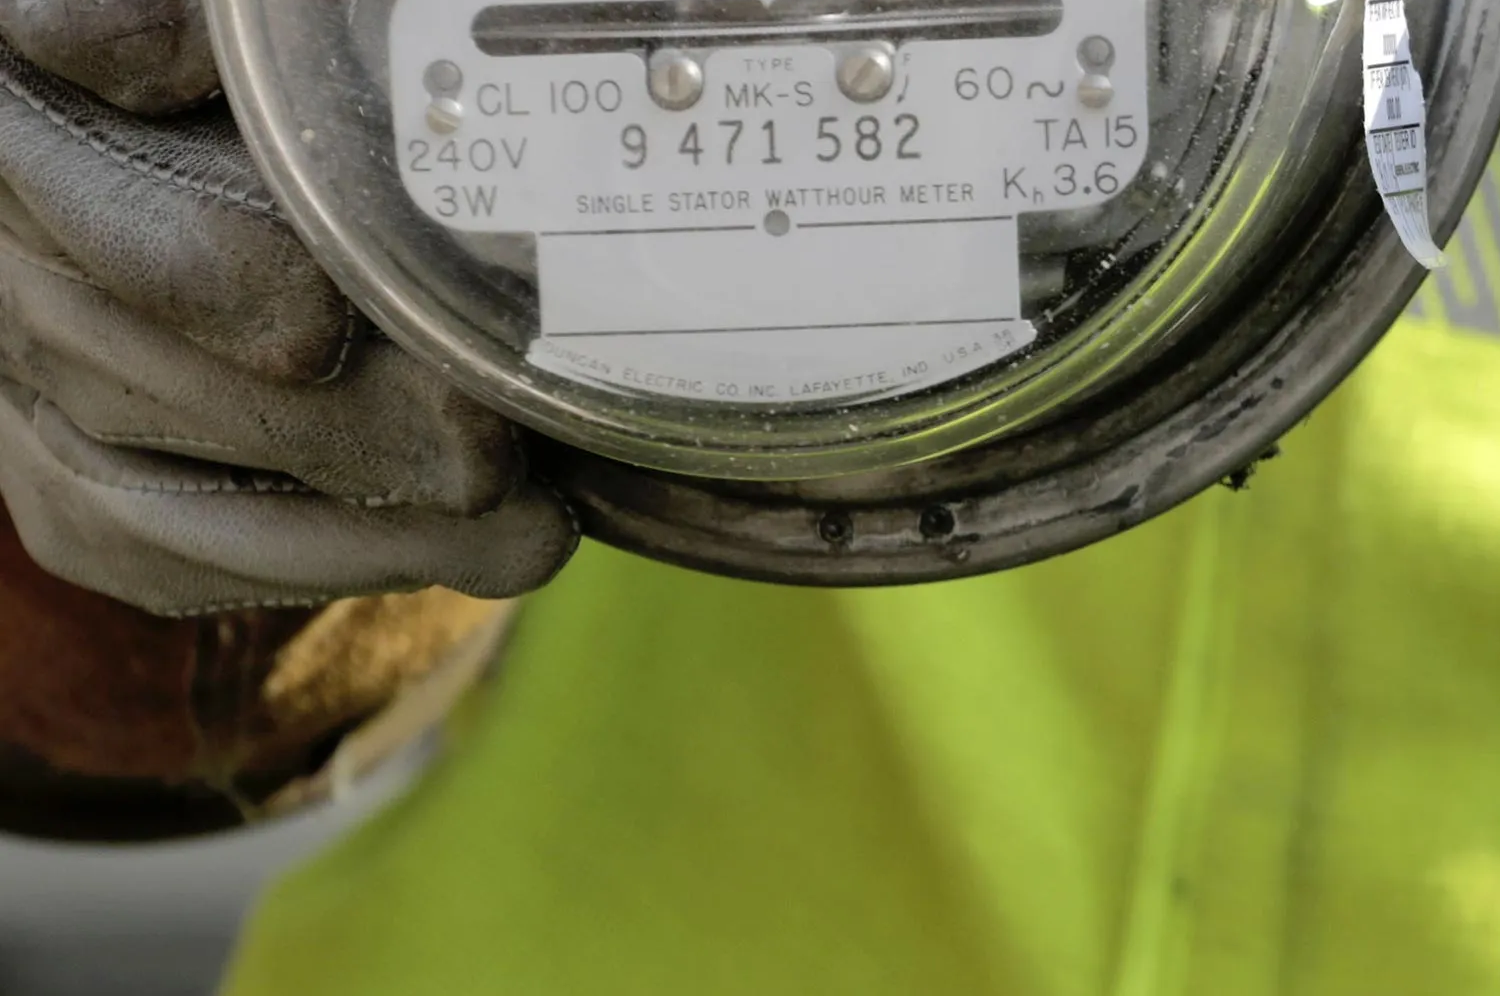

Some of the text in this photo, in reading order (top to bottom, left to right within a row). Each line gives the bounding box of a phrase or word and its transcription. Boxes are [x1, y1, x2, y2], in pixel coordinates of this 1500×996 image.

[743, 56, 795, 72] TYPE
[476, 78, 623, 117] CL 100
[724, 80, 815, 109] MK-S
[620, 113, 922, 170] 9 471 582
[1033, 114, 1138, 152] TA 15
[408, 136, 527, 173] 240V
[1053, 161, 1119, 197] 3.6
[434, 185, 498, 218] 3W
[575, 182, 974, 215] SINGLE STATOR WATTHOUR METER
[545, 340, 612, 375] DUNCAN
[622, 366, 704, 394] ELECTRIC
